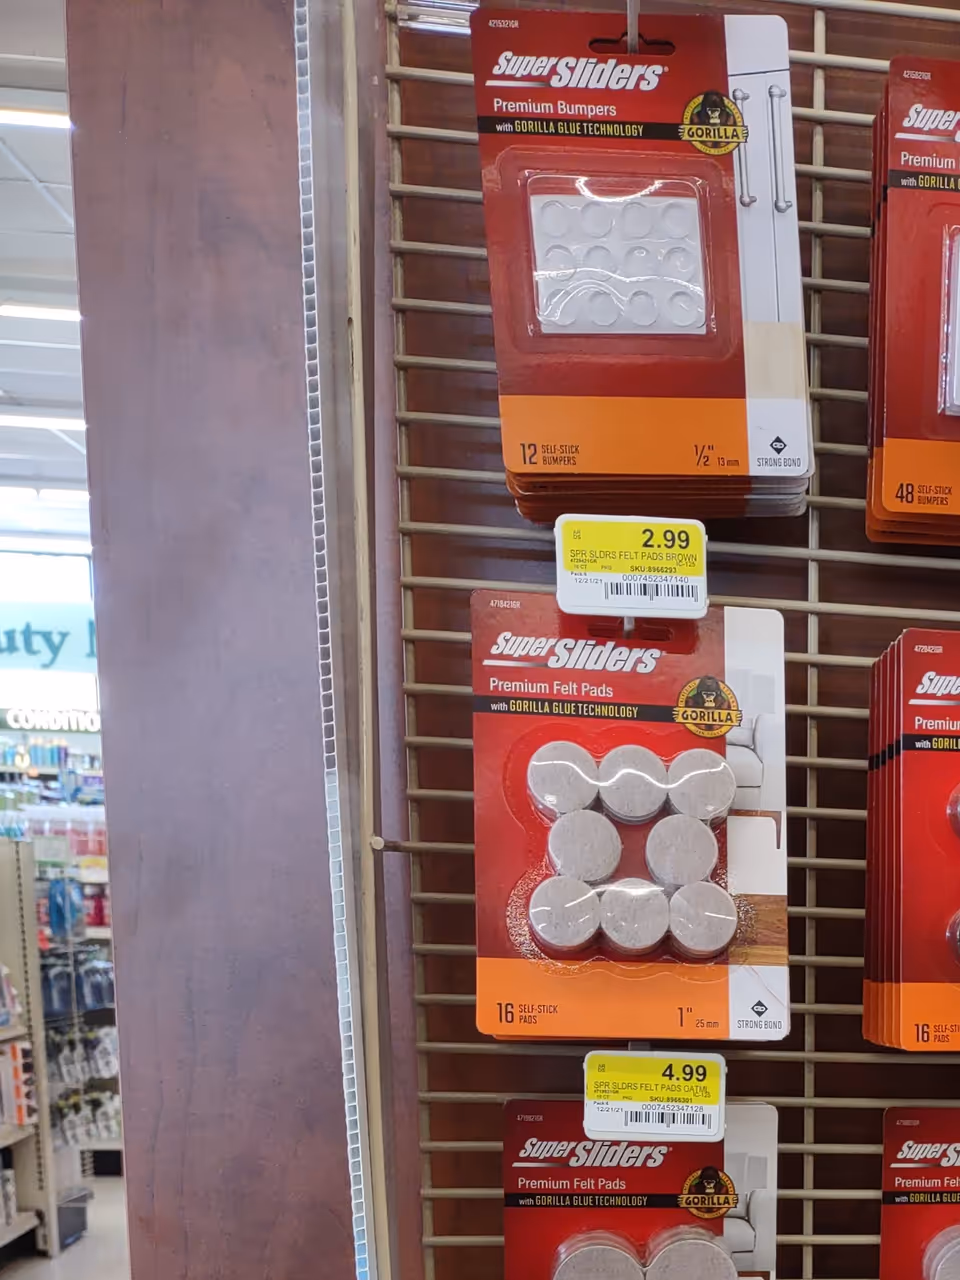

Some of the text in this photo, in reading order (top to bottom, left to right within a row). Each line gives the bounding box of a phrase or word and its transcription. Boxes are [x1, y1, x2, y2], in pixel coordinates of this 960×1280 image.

[494, 98, 616, 118] Premium Bumpers
[496, 120, 644, 137] with GORILLA GLUE TECHNOLOGY
[687, 127, 740, 140] GORILLA
[901, 152, 955, 169] Premium
[901, 178, 917, 187] with
[919, 175, 955, 189] GORILLA
[543, 456, 577, 465] BUMPERS
[642, 529, 690, 549] 2.99
[490, 678, 614, 698] Premium Felt Pads
[491, 700, 638, 718] with GORILLA GLUE TECHNOLOGY
[915, 740, 931, 749] with
[497, 1002, 558, 1024] 16 SELF-STICK
[914, 1023, 930, 1043] 16
[662, 1063, 707, 1082] 4.99
[518, 1178, 626, 1190] Premium Felt Pads
[895, 1177, 941, 1188] Premium
[685, 1196, 730, 1206] GORILLA
